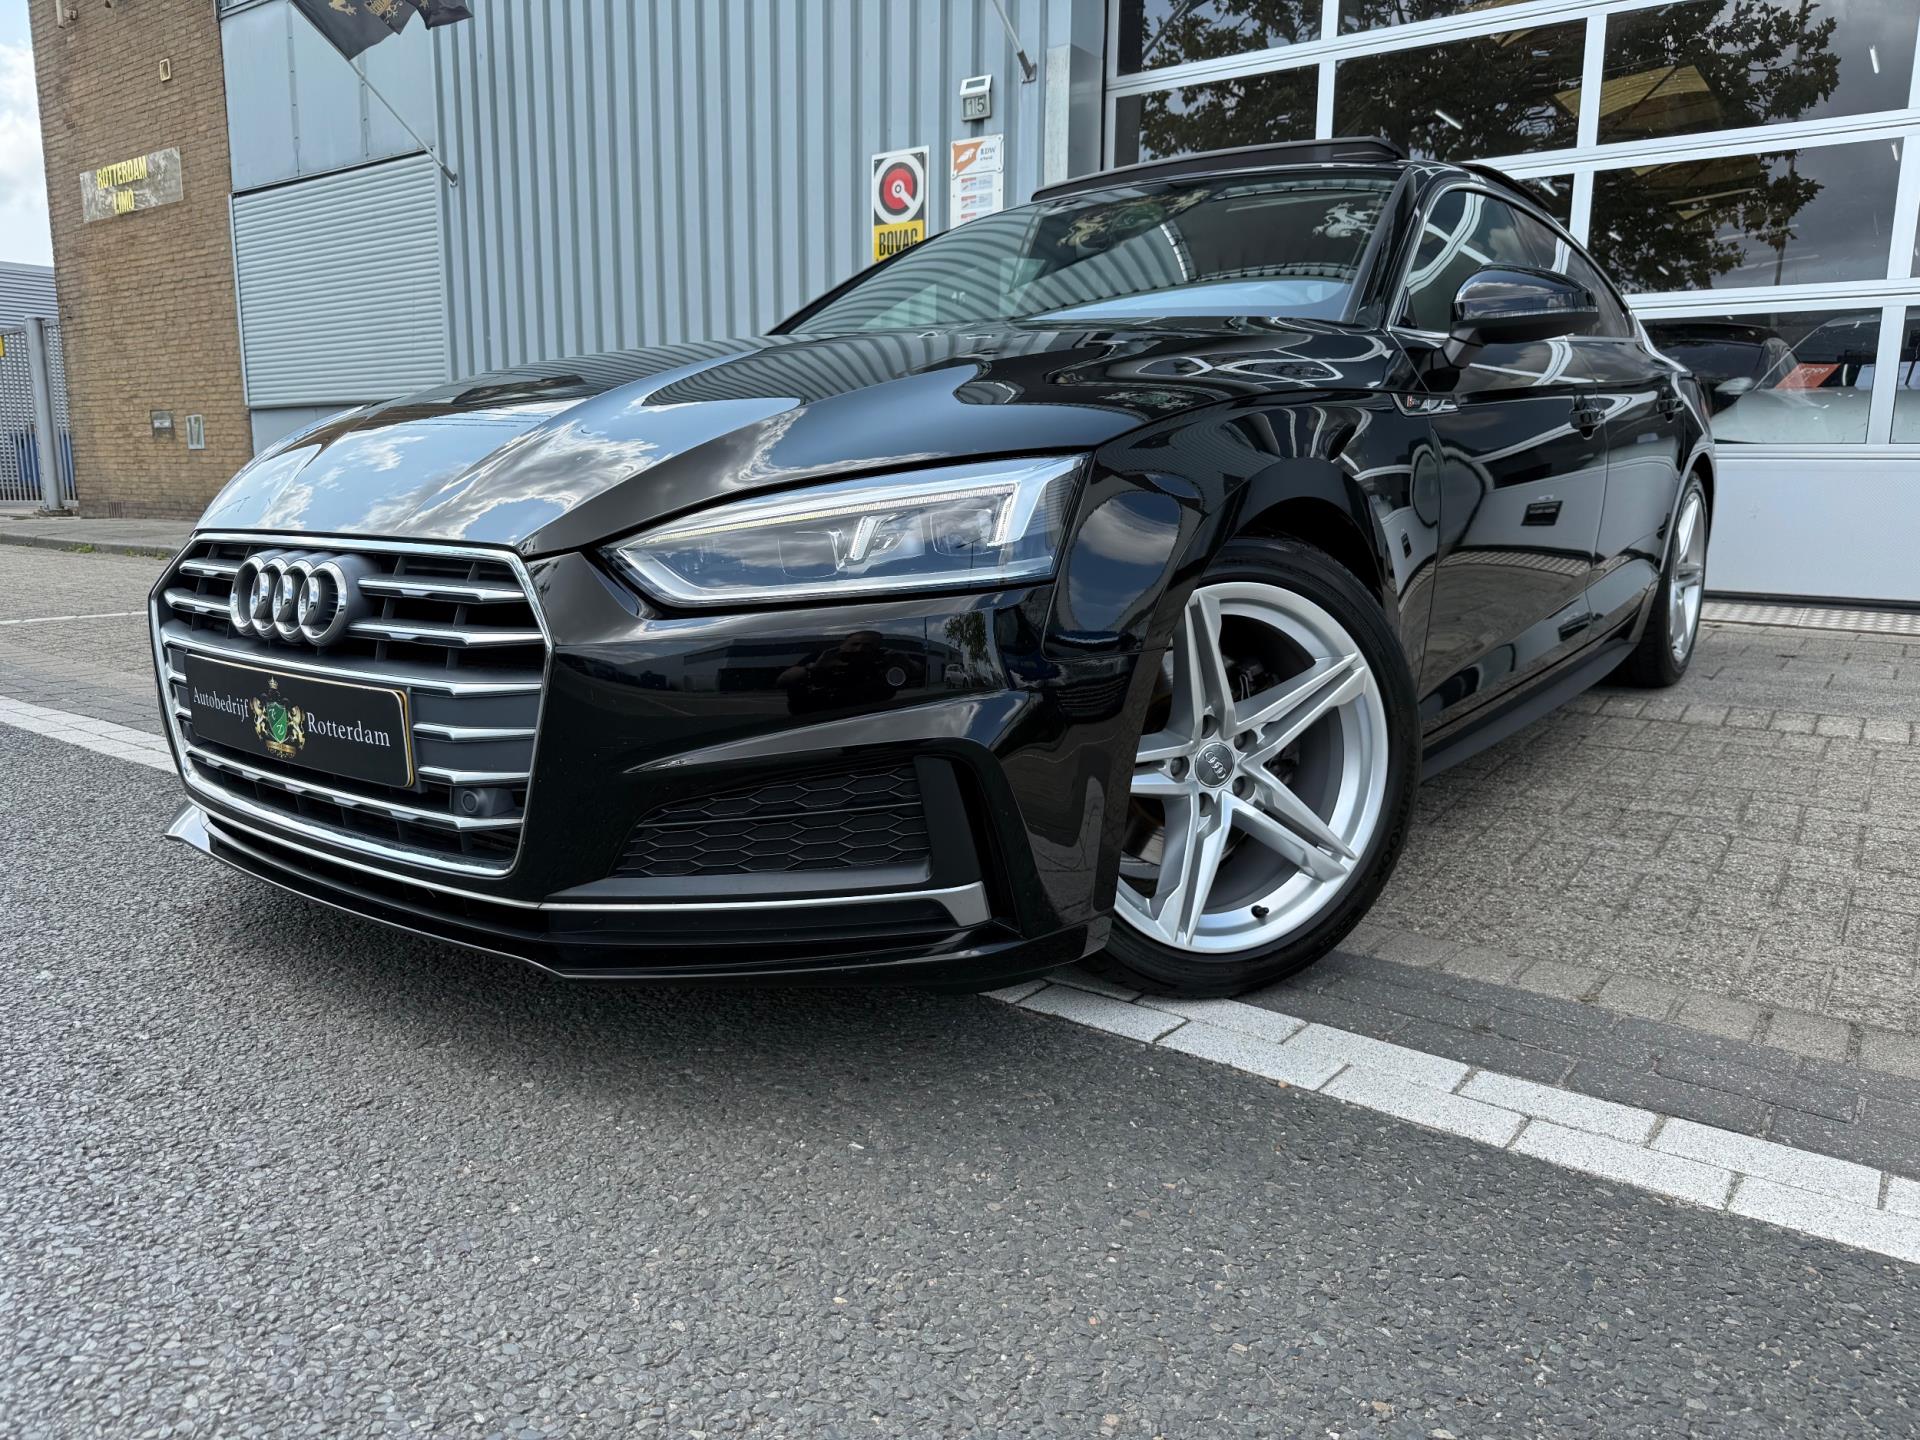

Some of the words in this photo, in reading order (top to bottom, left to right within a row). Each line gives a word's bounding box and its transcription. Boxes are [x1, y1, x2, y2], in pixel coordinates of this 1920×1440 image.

[967, 96, 985, 114] 15
[96, 155, 147, 190] ROTTERDAM
[112, 190, 135, 215] LIMO
[193, 687, 249, 723] Autobedrijf
[307, 712, 391, 747] Rotterdam
